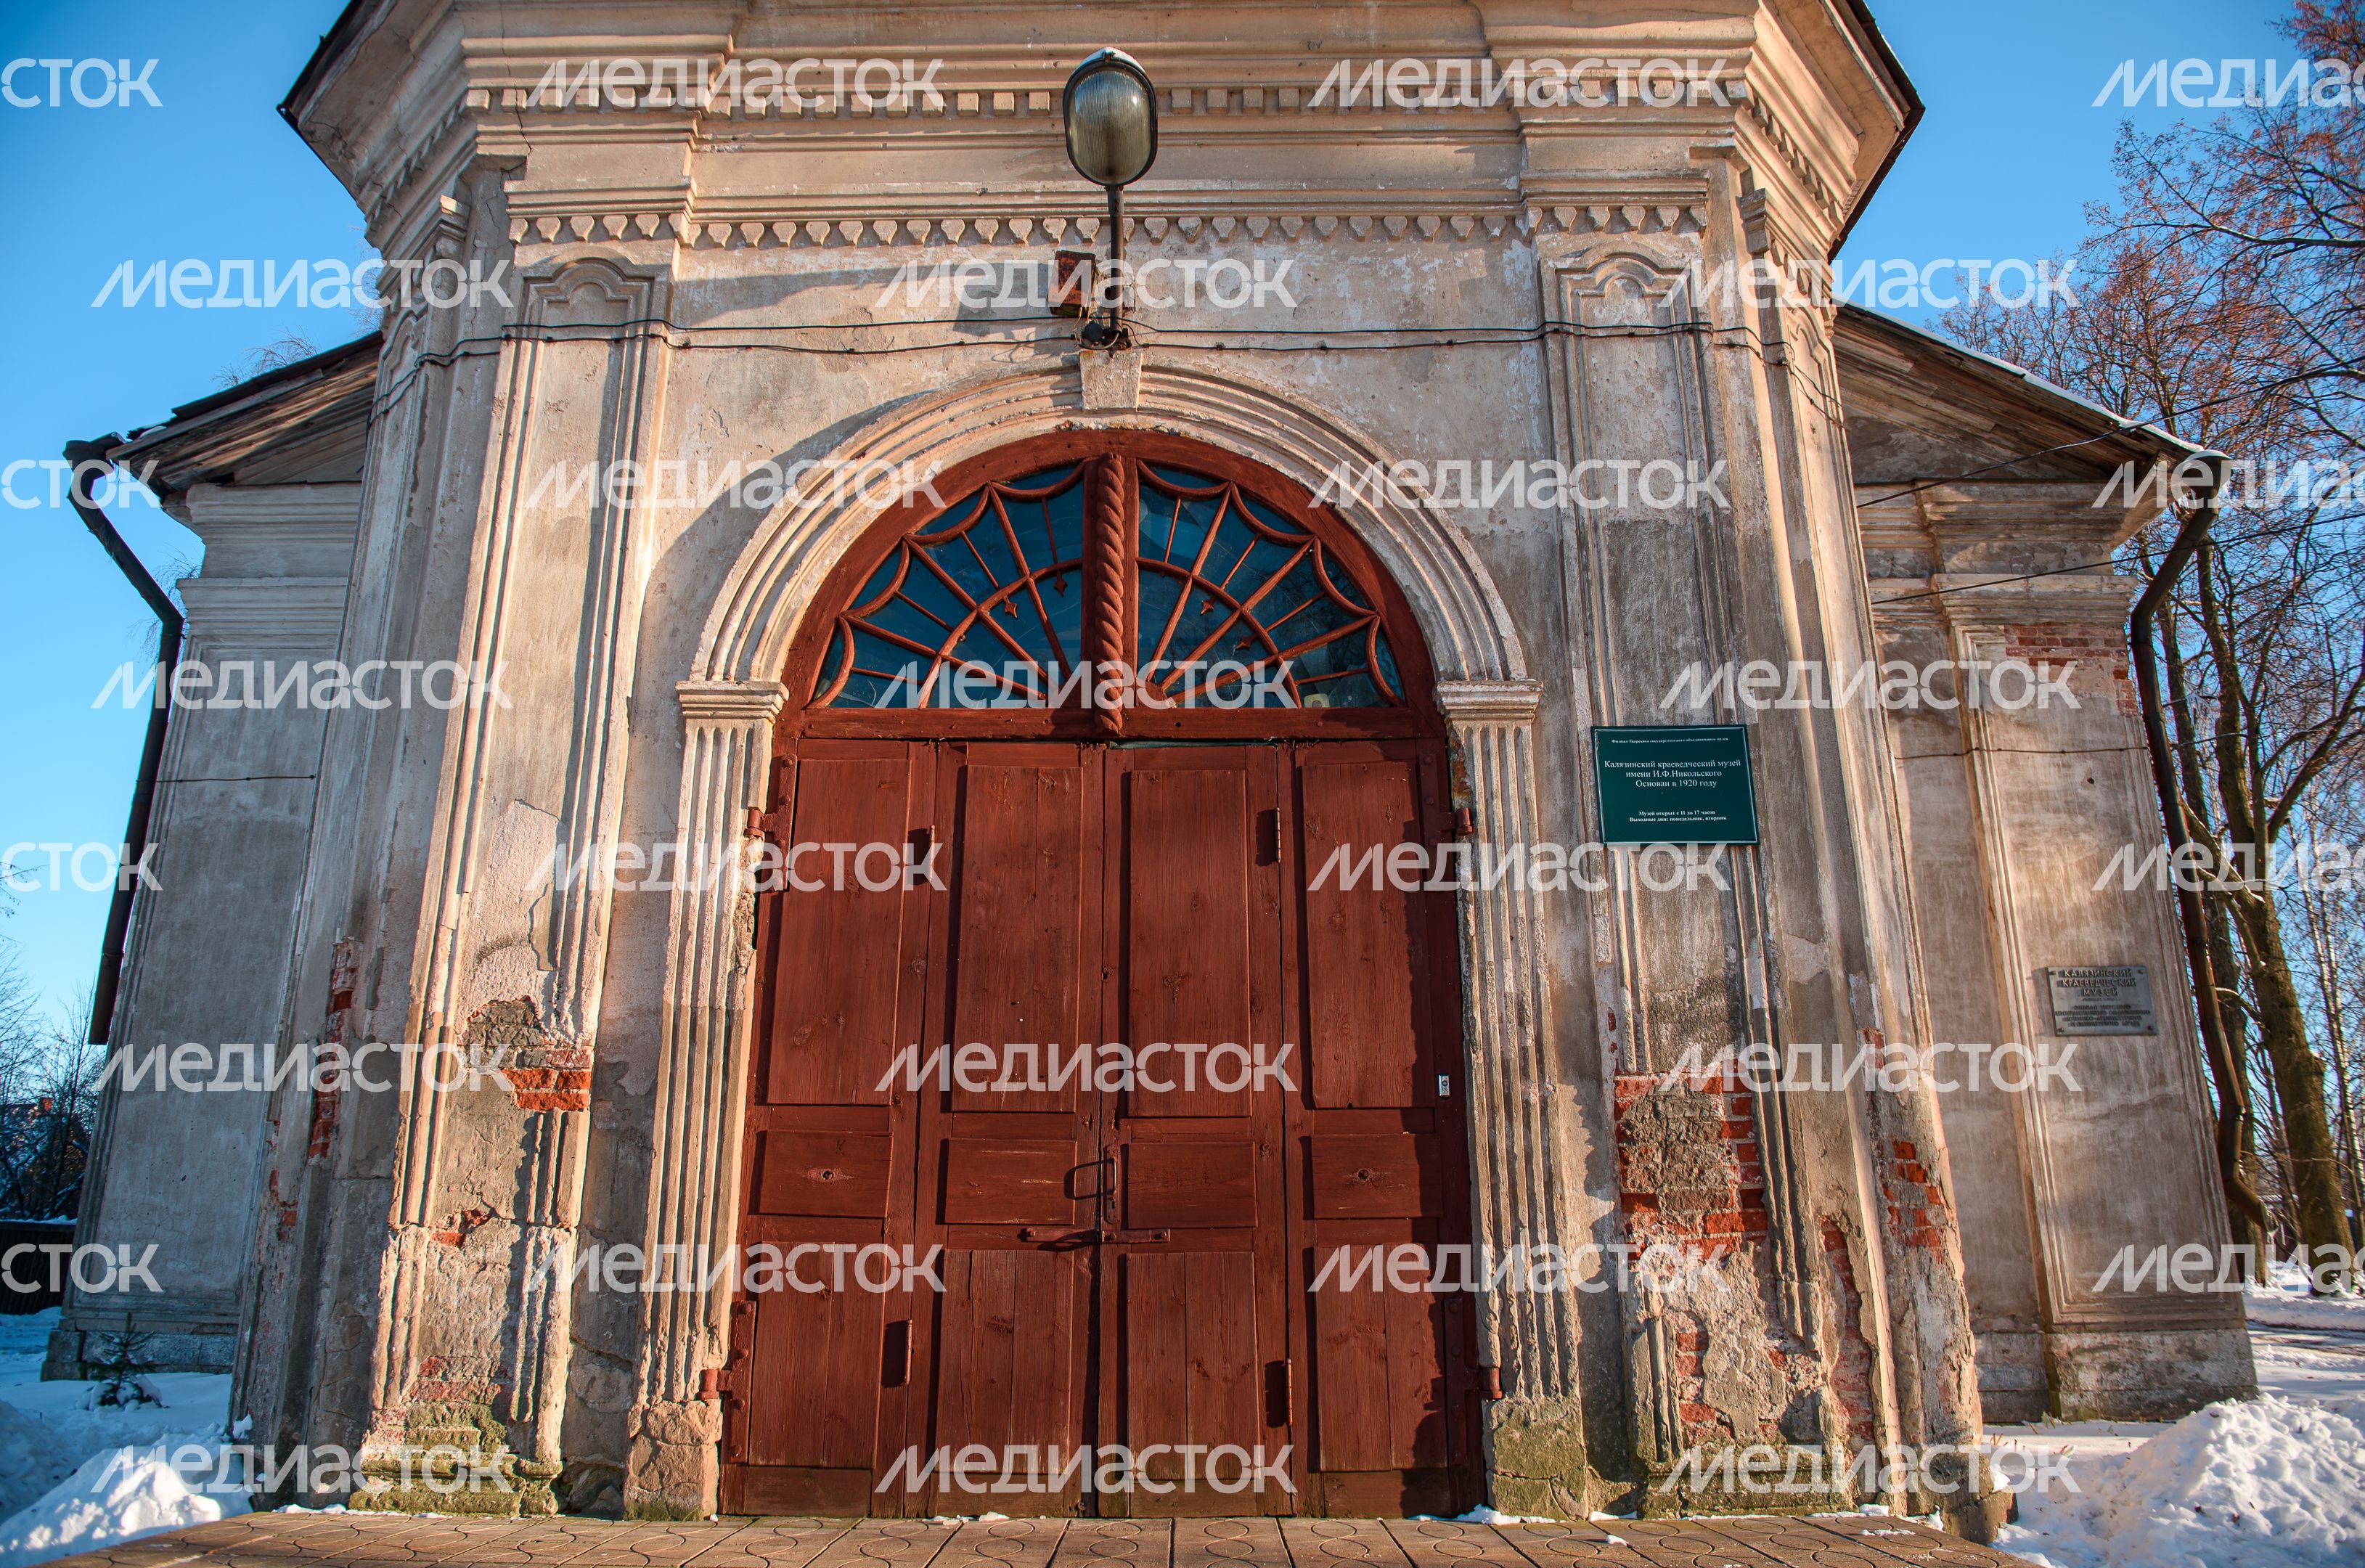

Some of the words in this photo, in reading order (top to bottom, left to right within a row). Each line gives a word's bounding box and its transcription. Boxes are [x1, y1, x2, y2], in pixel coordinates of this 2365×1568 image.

[1657, 759, 1715, 770] краеведческий
[1717, 759, 1741, 769] музей
[2063, 968, 2133, 978] КАЛЯЗИНСКИЙ
[2062, 978, 2137, 987] КРАЕВЕДЧЕСКИЙ
[2083, 987, 2119, 997] МУЗЕЙ
